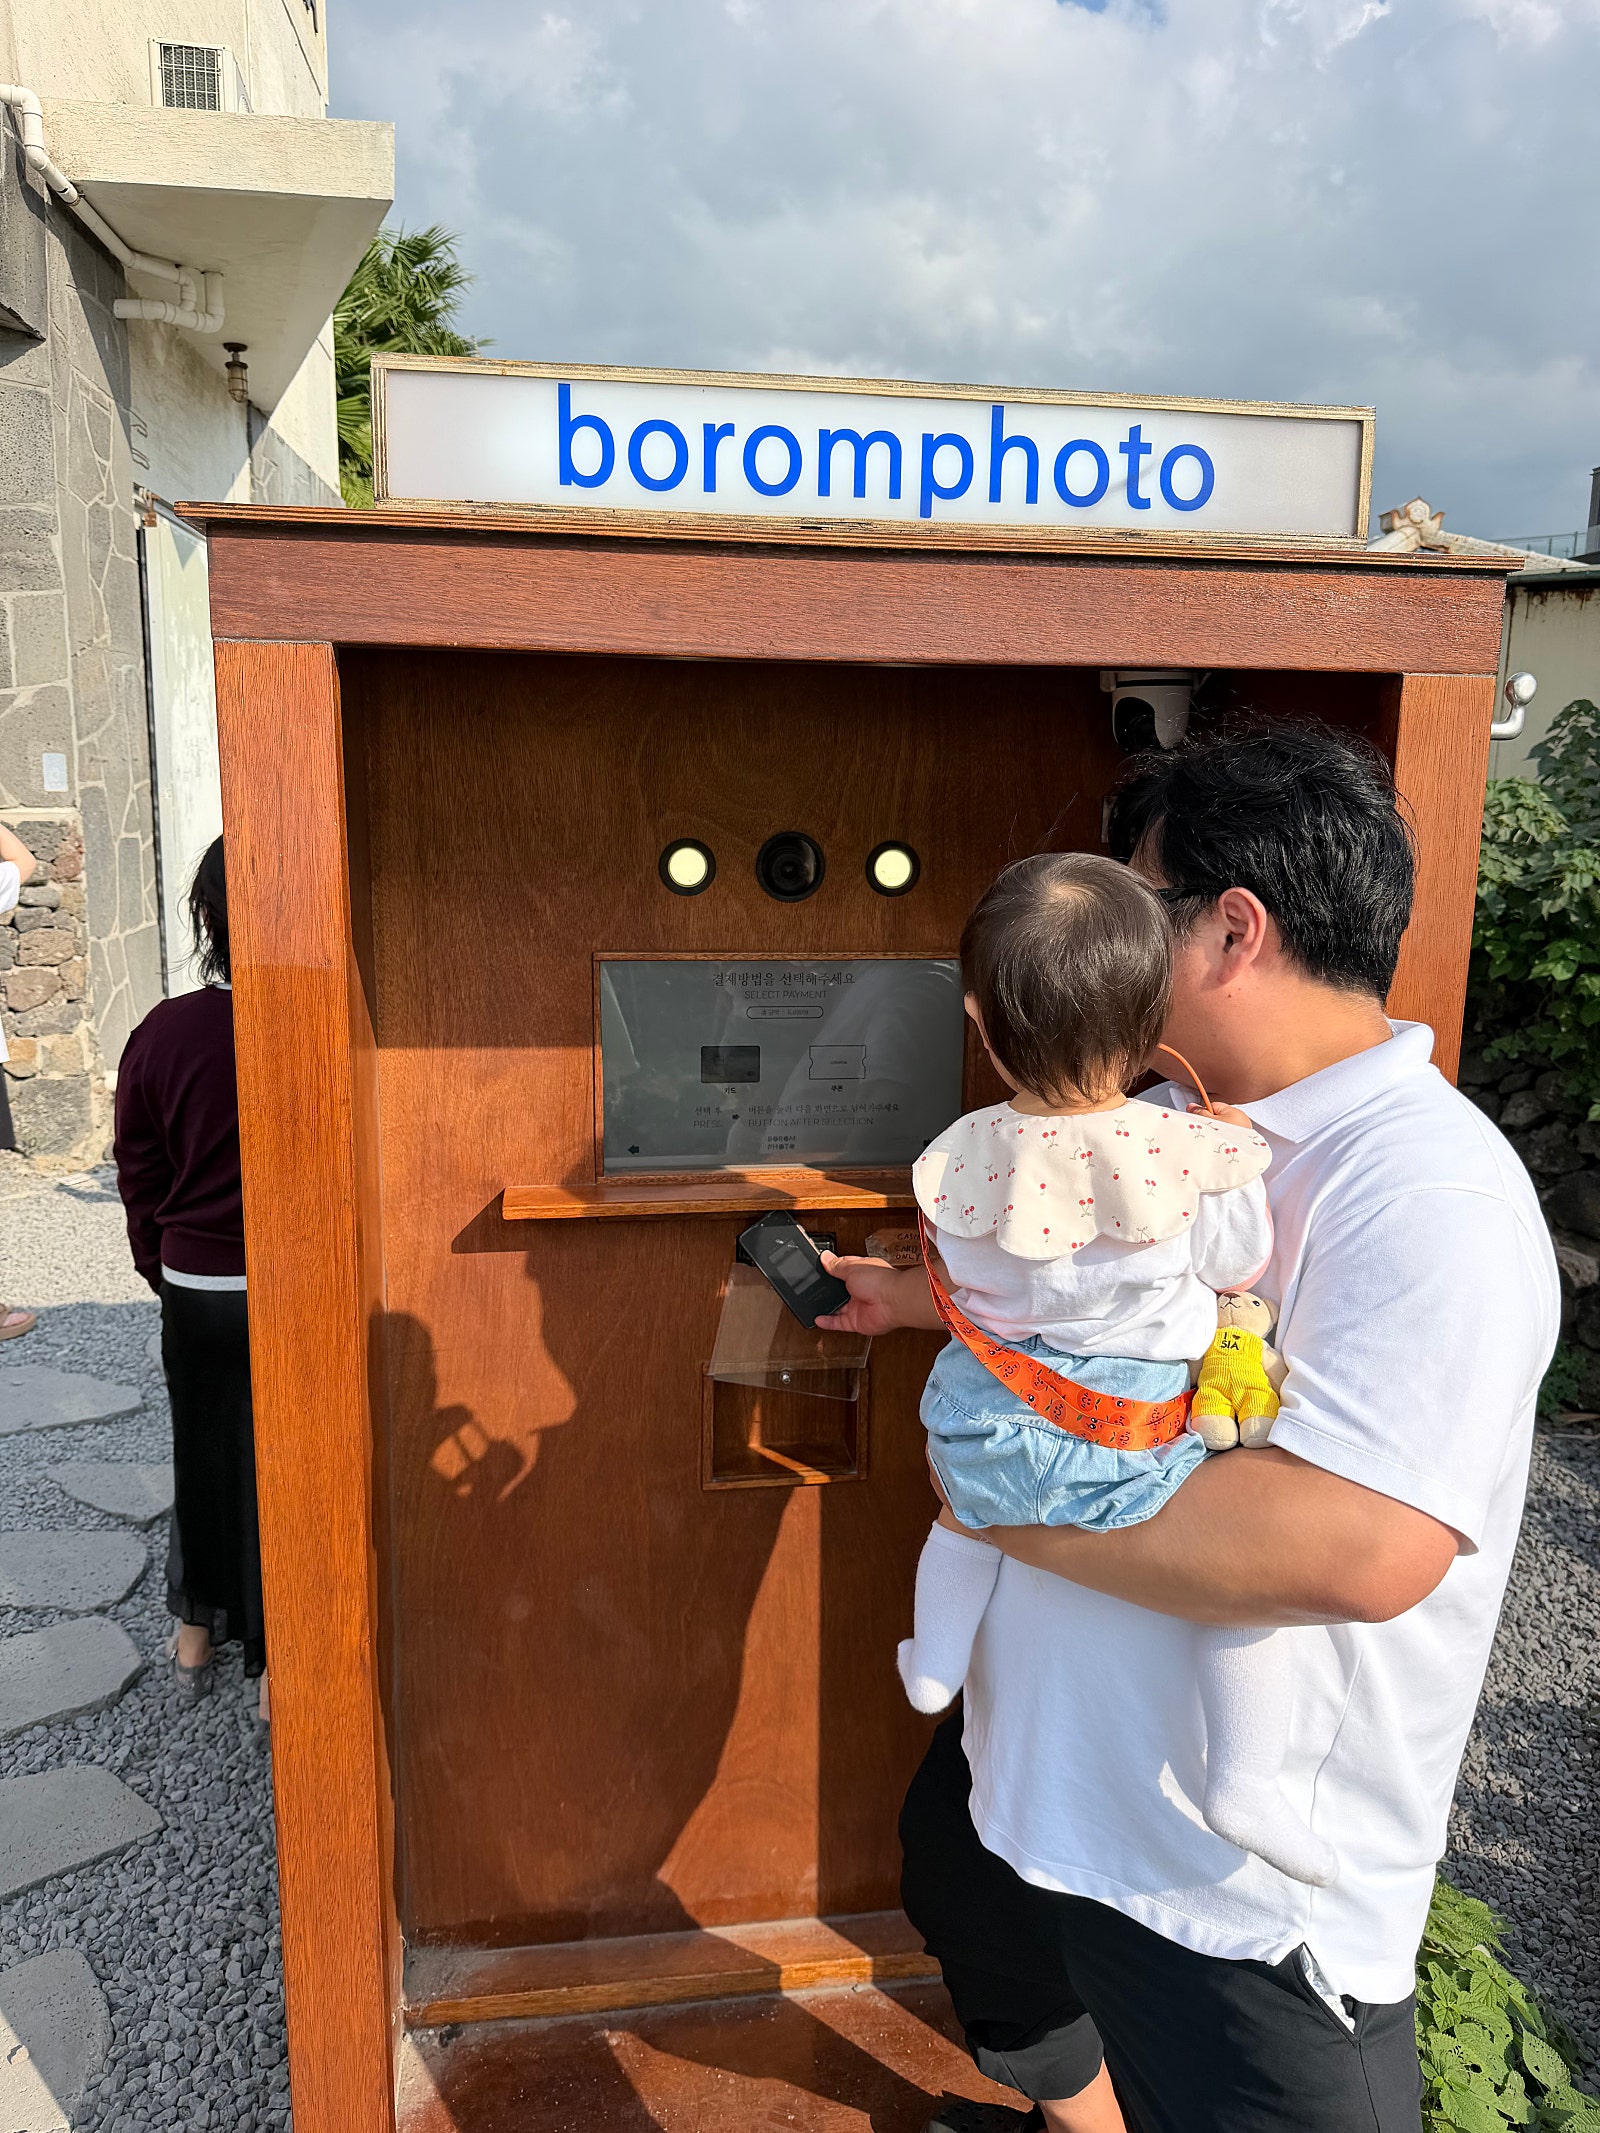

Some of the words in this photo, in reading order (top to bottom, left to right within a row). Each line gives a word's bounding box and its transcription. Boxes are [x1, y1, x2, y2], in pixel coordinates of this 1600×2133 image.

[557, 383, 1215, 518] boromphoto
[780, 972, 855, 986] 선택해주세요
[744, 990, 780, 1000] SELECT
[783, 990, 827, 1000] PAYMENT
[693, 1119, 724, 1128] PRESS
[748, 1118, 788, 1127] BUTTON
[789, 1117, 820, 1126] AFTER
[821, 1117, 874, 1126] SELECTION
[767, 1135, 796, 1143] BOROM
[767, 1143, 796, 1151] PHOTO
[1223, 1331, 1228, 1340] I
[1220, 1340, 1240, 1351] SIA
